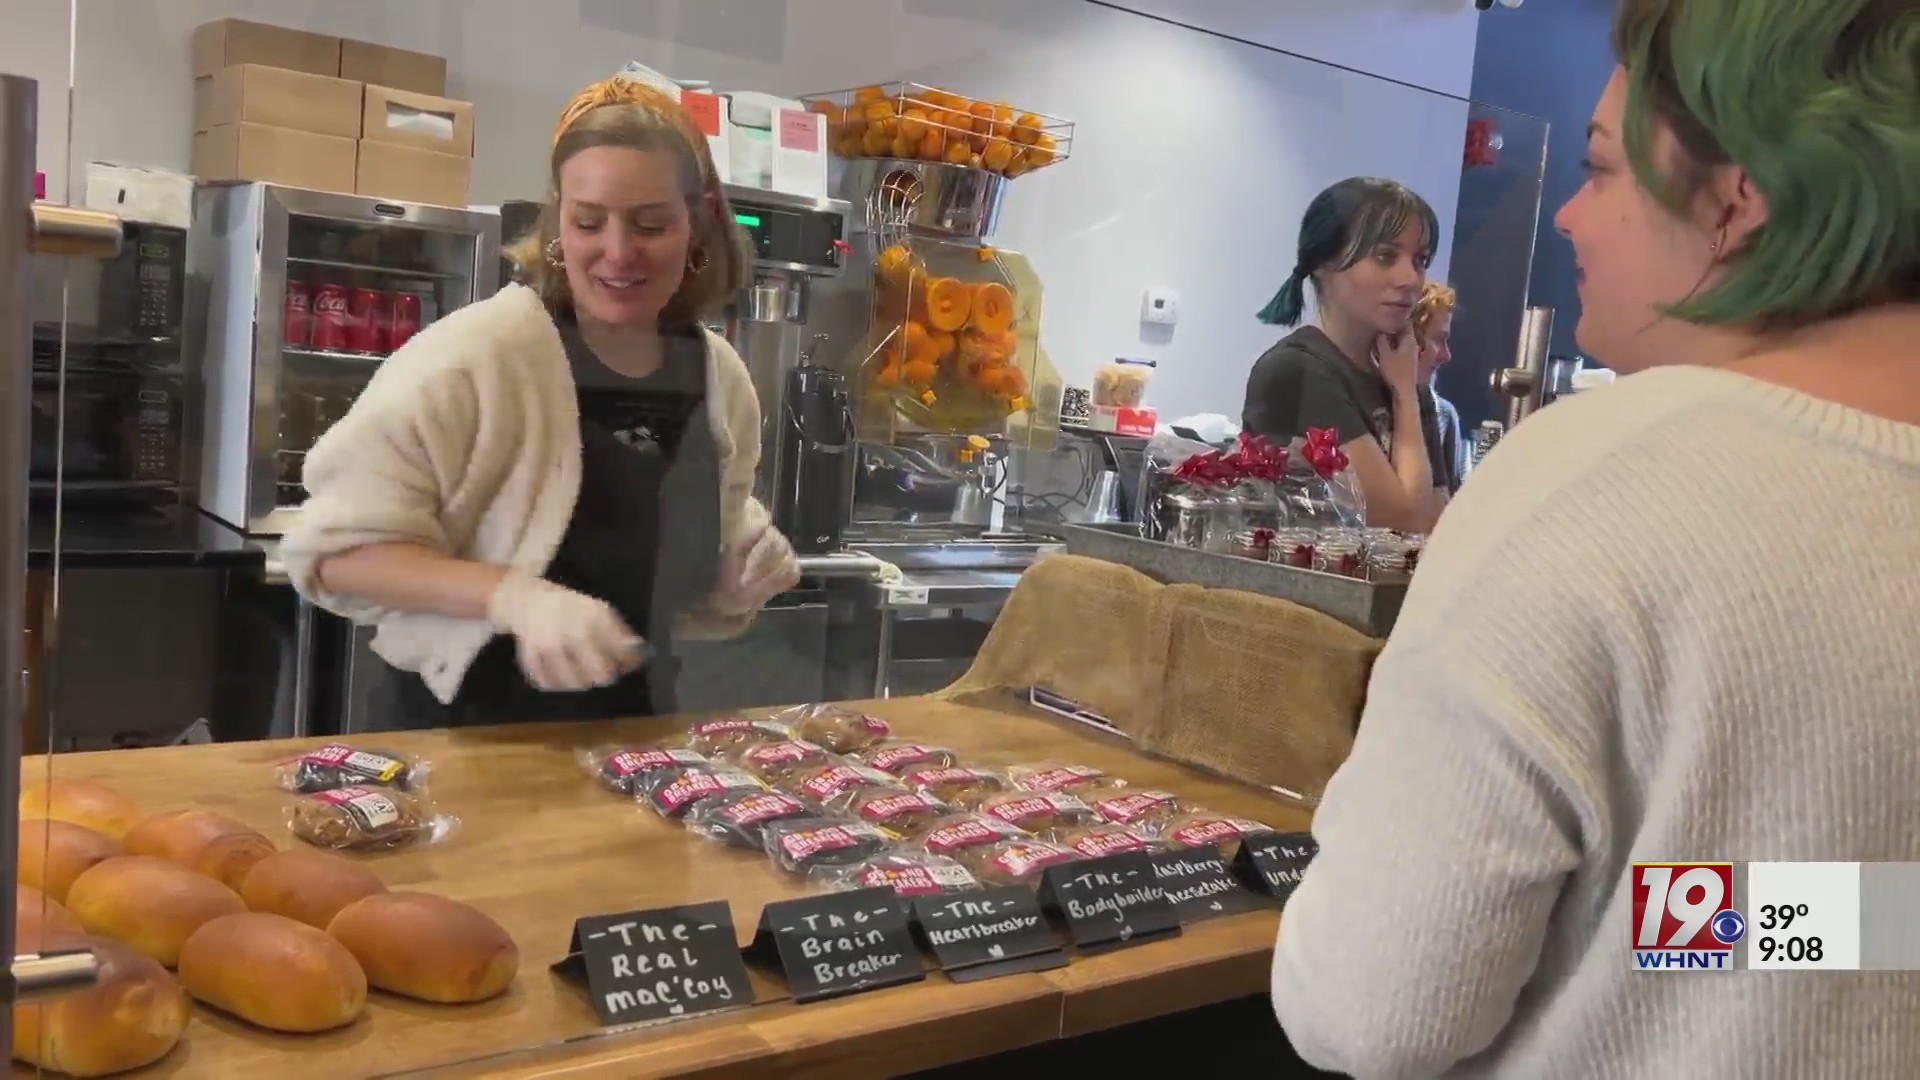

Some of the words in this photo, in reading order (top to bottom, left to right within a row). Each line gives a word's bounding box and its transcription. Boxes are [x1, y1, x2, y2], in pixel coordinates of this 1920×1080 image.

[1067, 886, 1164, 923] Bodybuilder
[800, 928, 886, 959] Brain
[929, 915, 1039, 946] Heartbreaker
[611, 947, 699, 978] Real
[814, 952, 902, 984] Breaker
